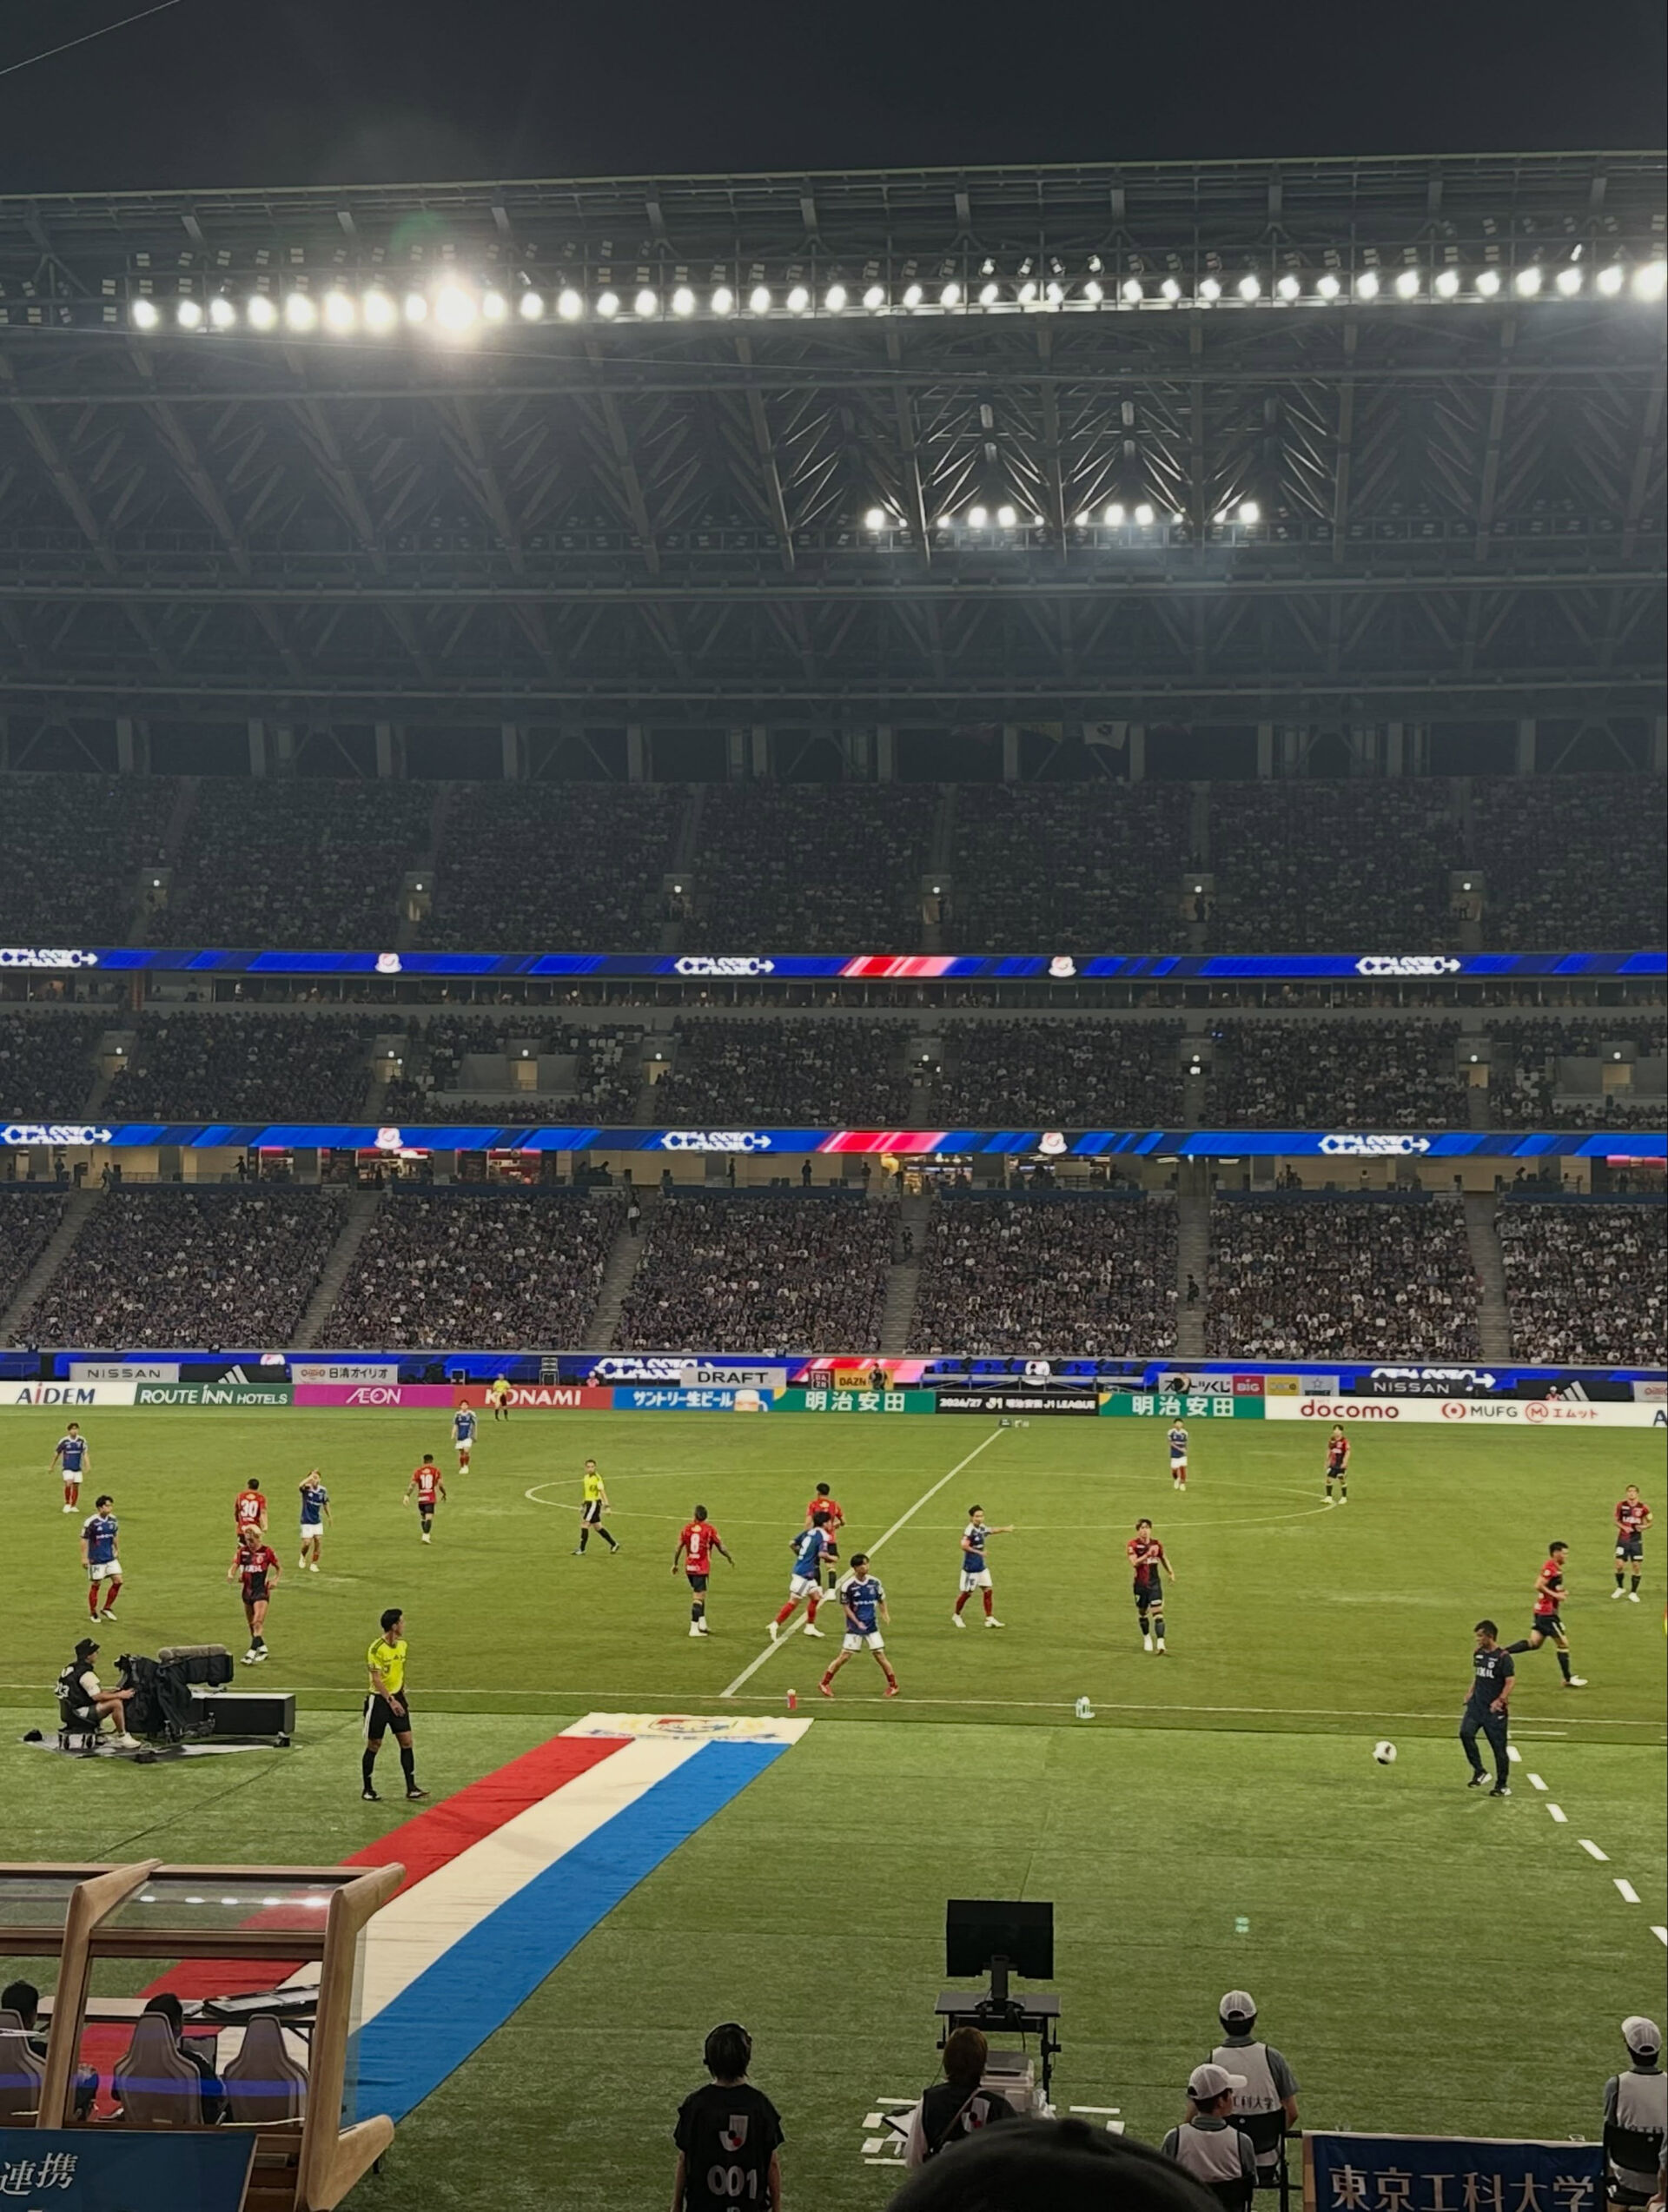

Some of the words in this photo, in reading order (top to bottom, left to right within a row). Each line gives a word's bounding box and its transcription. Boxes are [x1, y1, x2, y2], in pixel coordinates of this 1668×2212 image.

[87, 1368, 161, 1378] NISSAN
[329, 1368, 389, 1379] 日清オイリオ
[698, 1372, 769, 1383] DRAFT
[839, 1377, 867, 1386] DAZN
[1373, 1382, 1450, 1394] NISSAN
[140, 1389, 198, 1404] ROUTE
[236, 1393, 288, 1404] HOTELS
[485, 1389, 581, 1406] KONAMI
[633, 1391, 733, 1407] サントリー生ビール
[804, 1391, 905, 1412] 明治安田
[1132, 1395, 1234, 1417] 明治安田
[1301, 1399, 1400, 1419] docomo
[1470, 1406, 1518, 1417] MUFG
[1552, 1408, 1598, 1418] エムット
[241, 1500, 258, 1518] 30
[0, 2152, 78, 2195] 連携
[707, 2164, 758, 2199] 001
[1328, 2164, 1594, 2212] 東京工科大学
